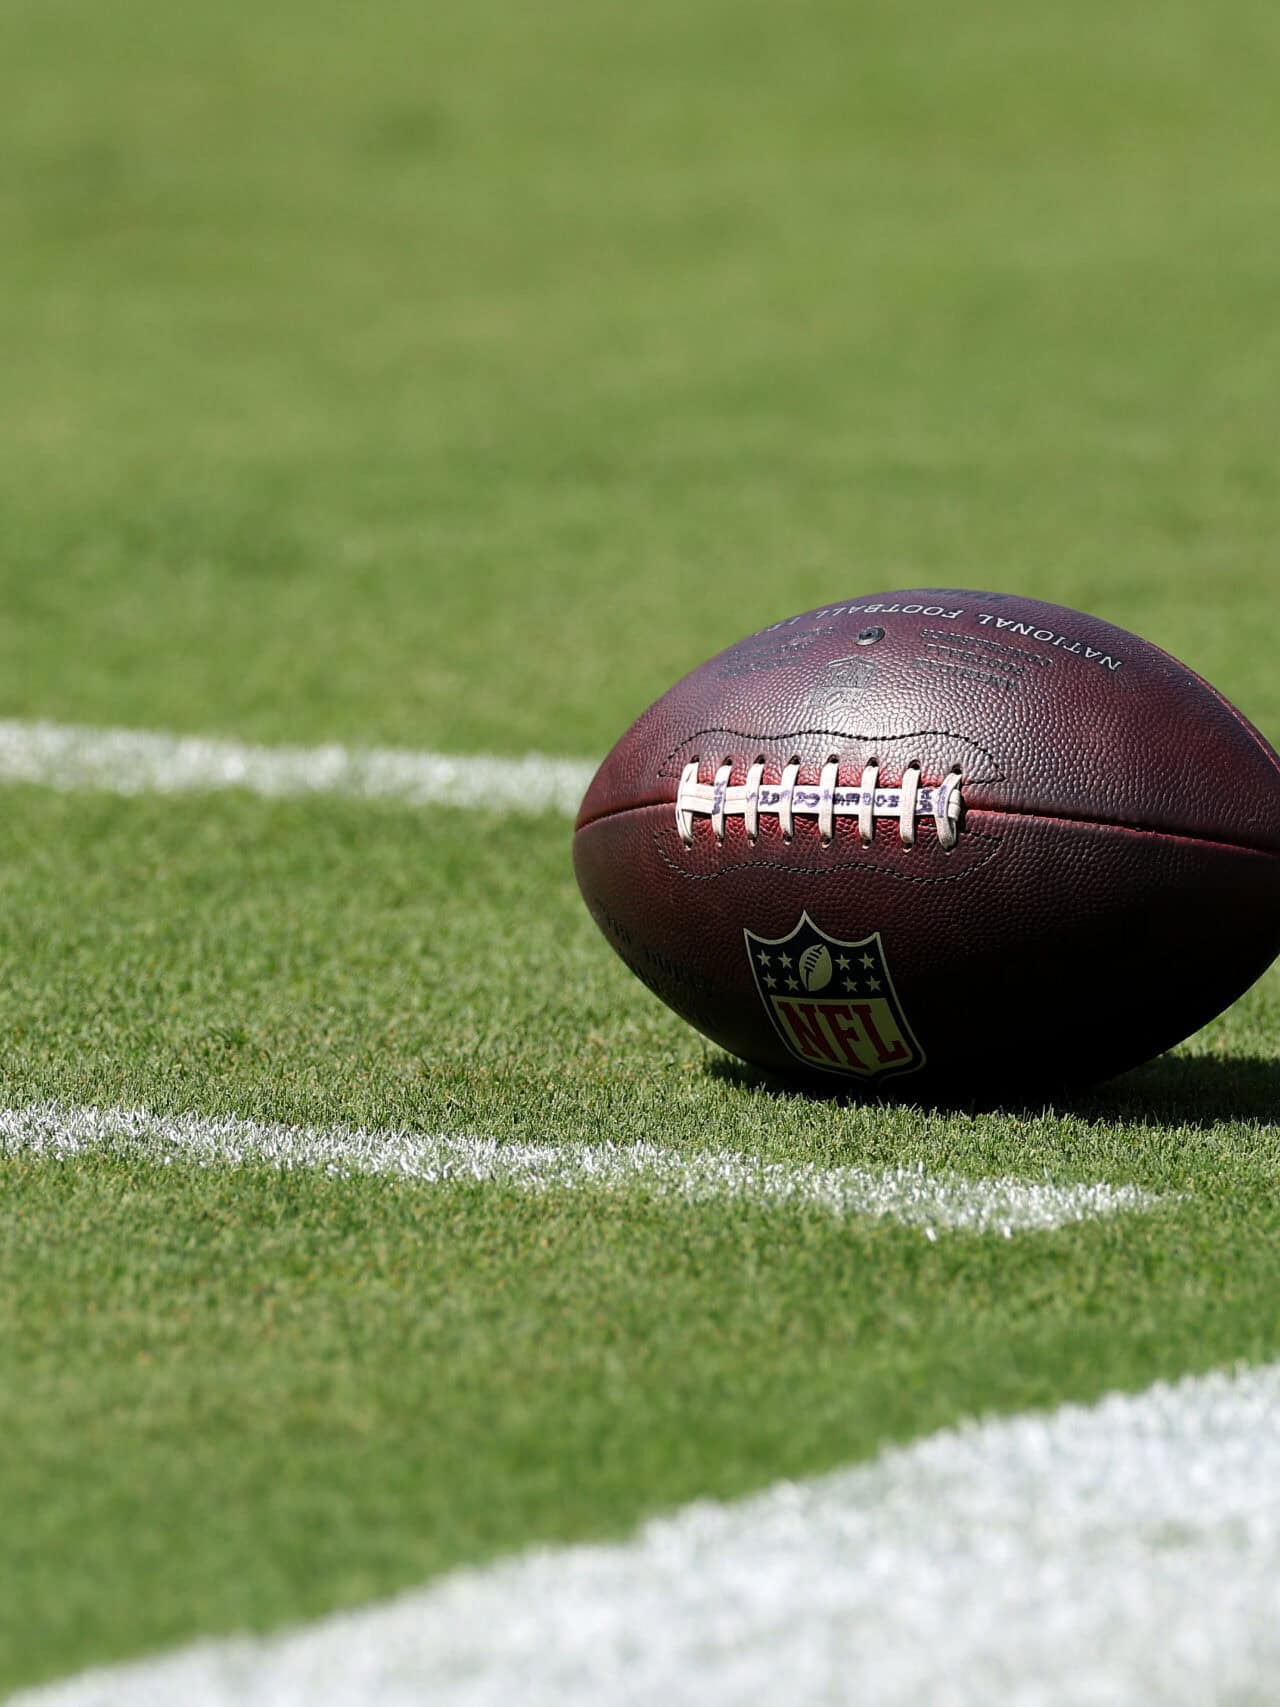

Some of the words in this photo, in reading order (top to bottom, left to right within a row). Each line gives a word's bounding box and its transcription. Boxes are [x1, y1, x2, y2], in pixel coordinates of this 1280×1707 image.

[816, 603, 965, 620] FOOTBALL
[978, 613, 1123, 672] NATIONAL
[776, 1001, 911, 1071] NFL
